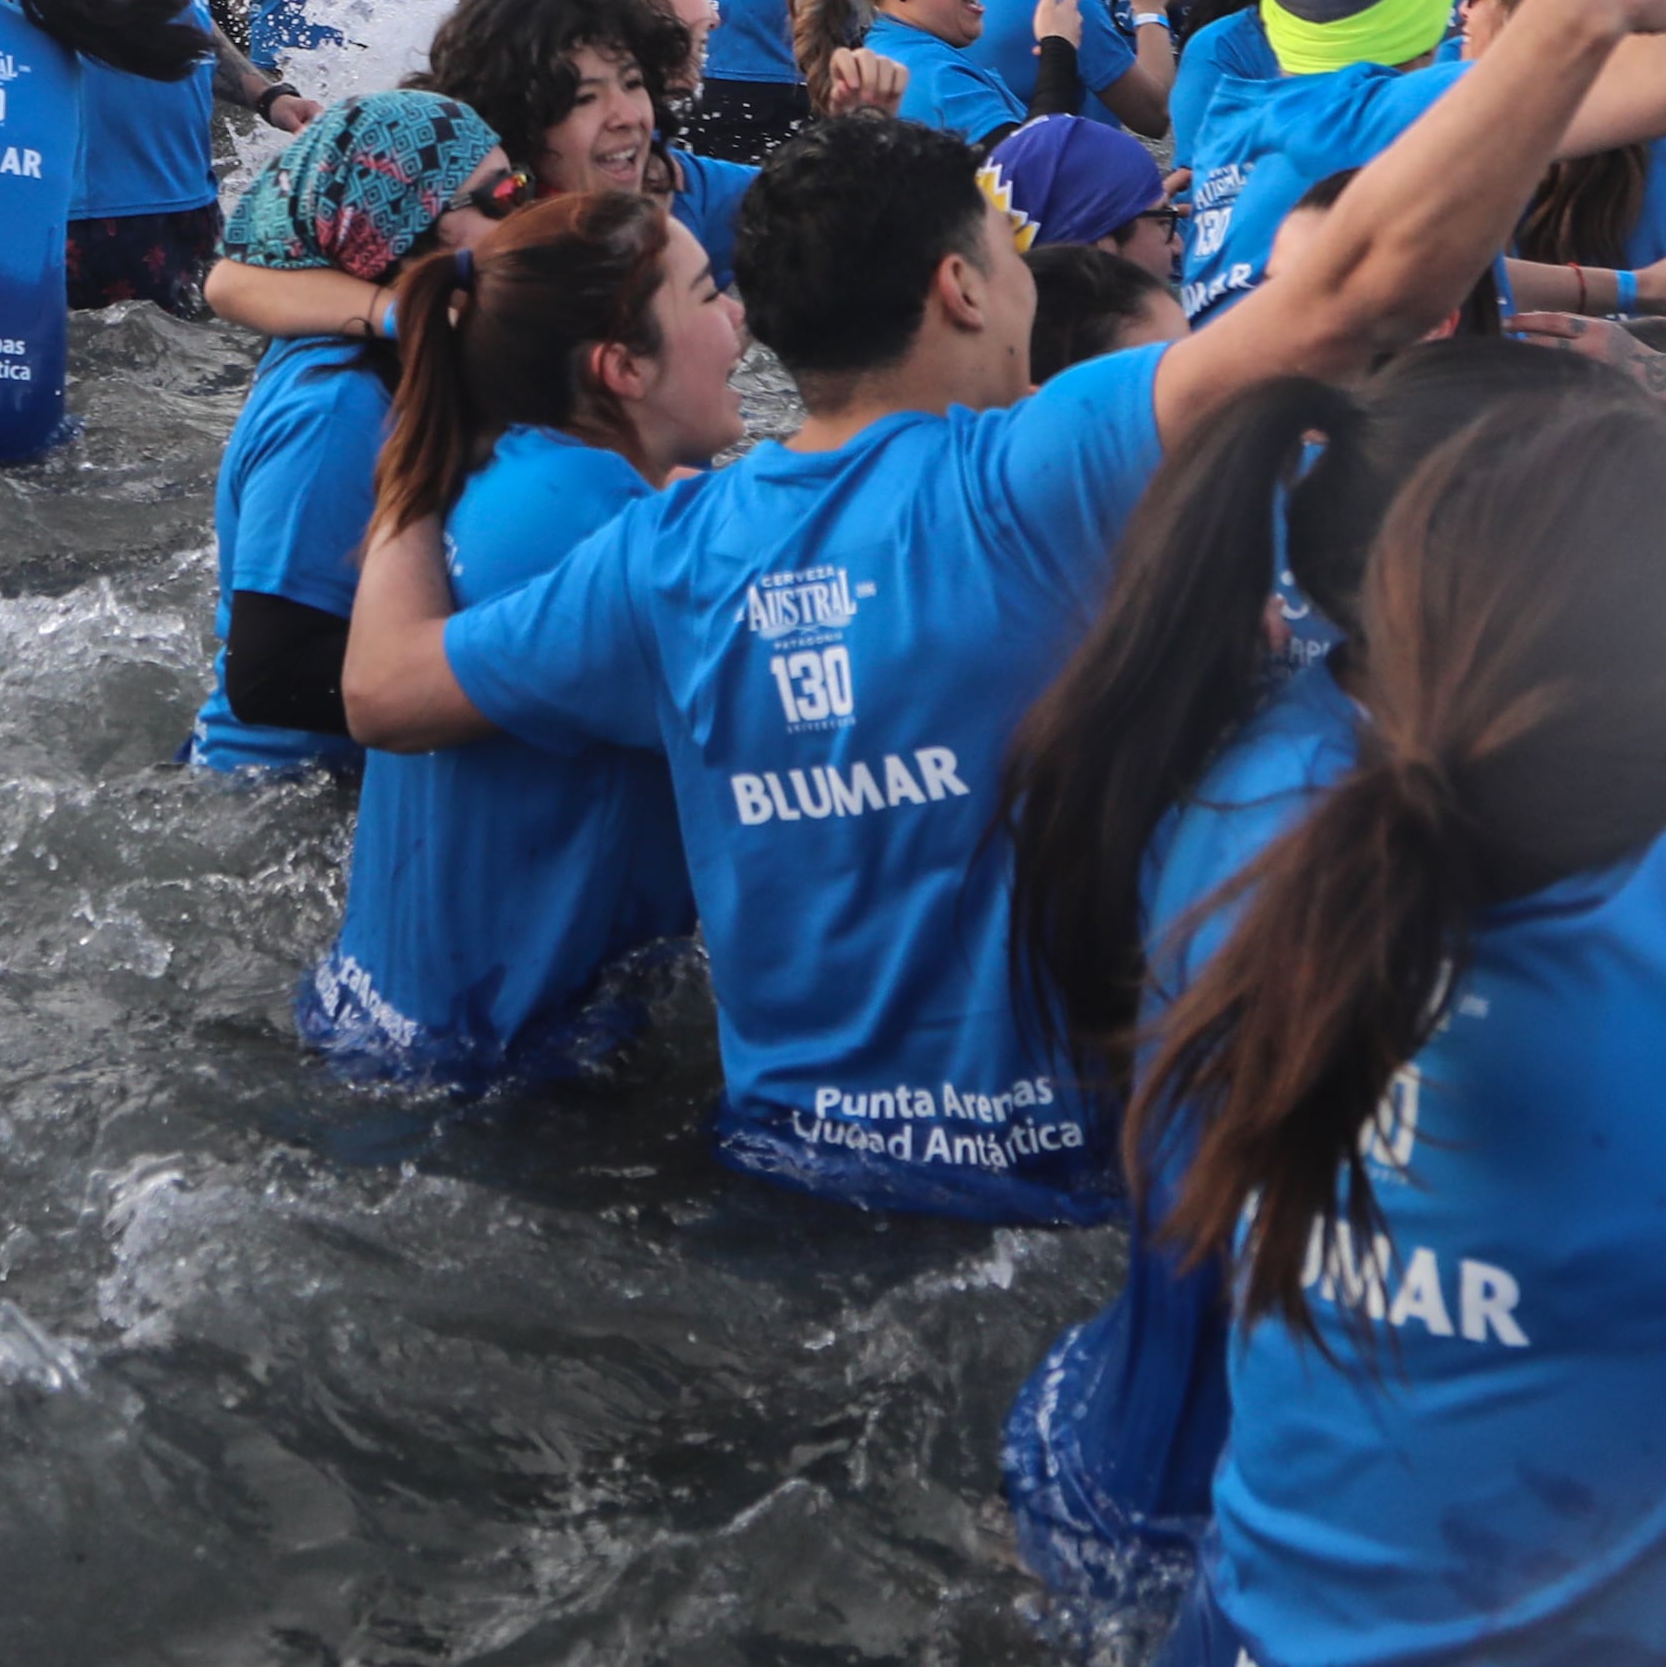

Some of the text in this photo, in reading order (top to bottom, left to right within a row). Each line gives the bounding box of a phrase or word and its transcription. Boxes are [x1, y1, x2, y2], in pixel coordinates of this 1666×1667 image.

[747, 567, 858, 632] AUSTRAL
[761, 564, 835, 589] CERVEZA
[770, 644, 854, 724] 130
[730, 745, 971, 826] BLUMAR
[814, 1084, 936, 1120] Punta
